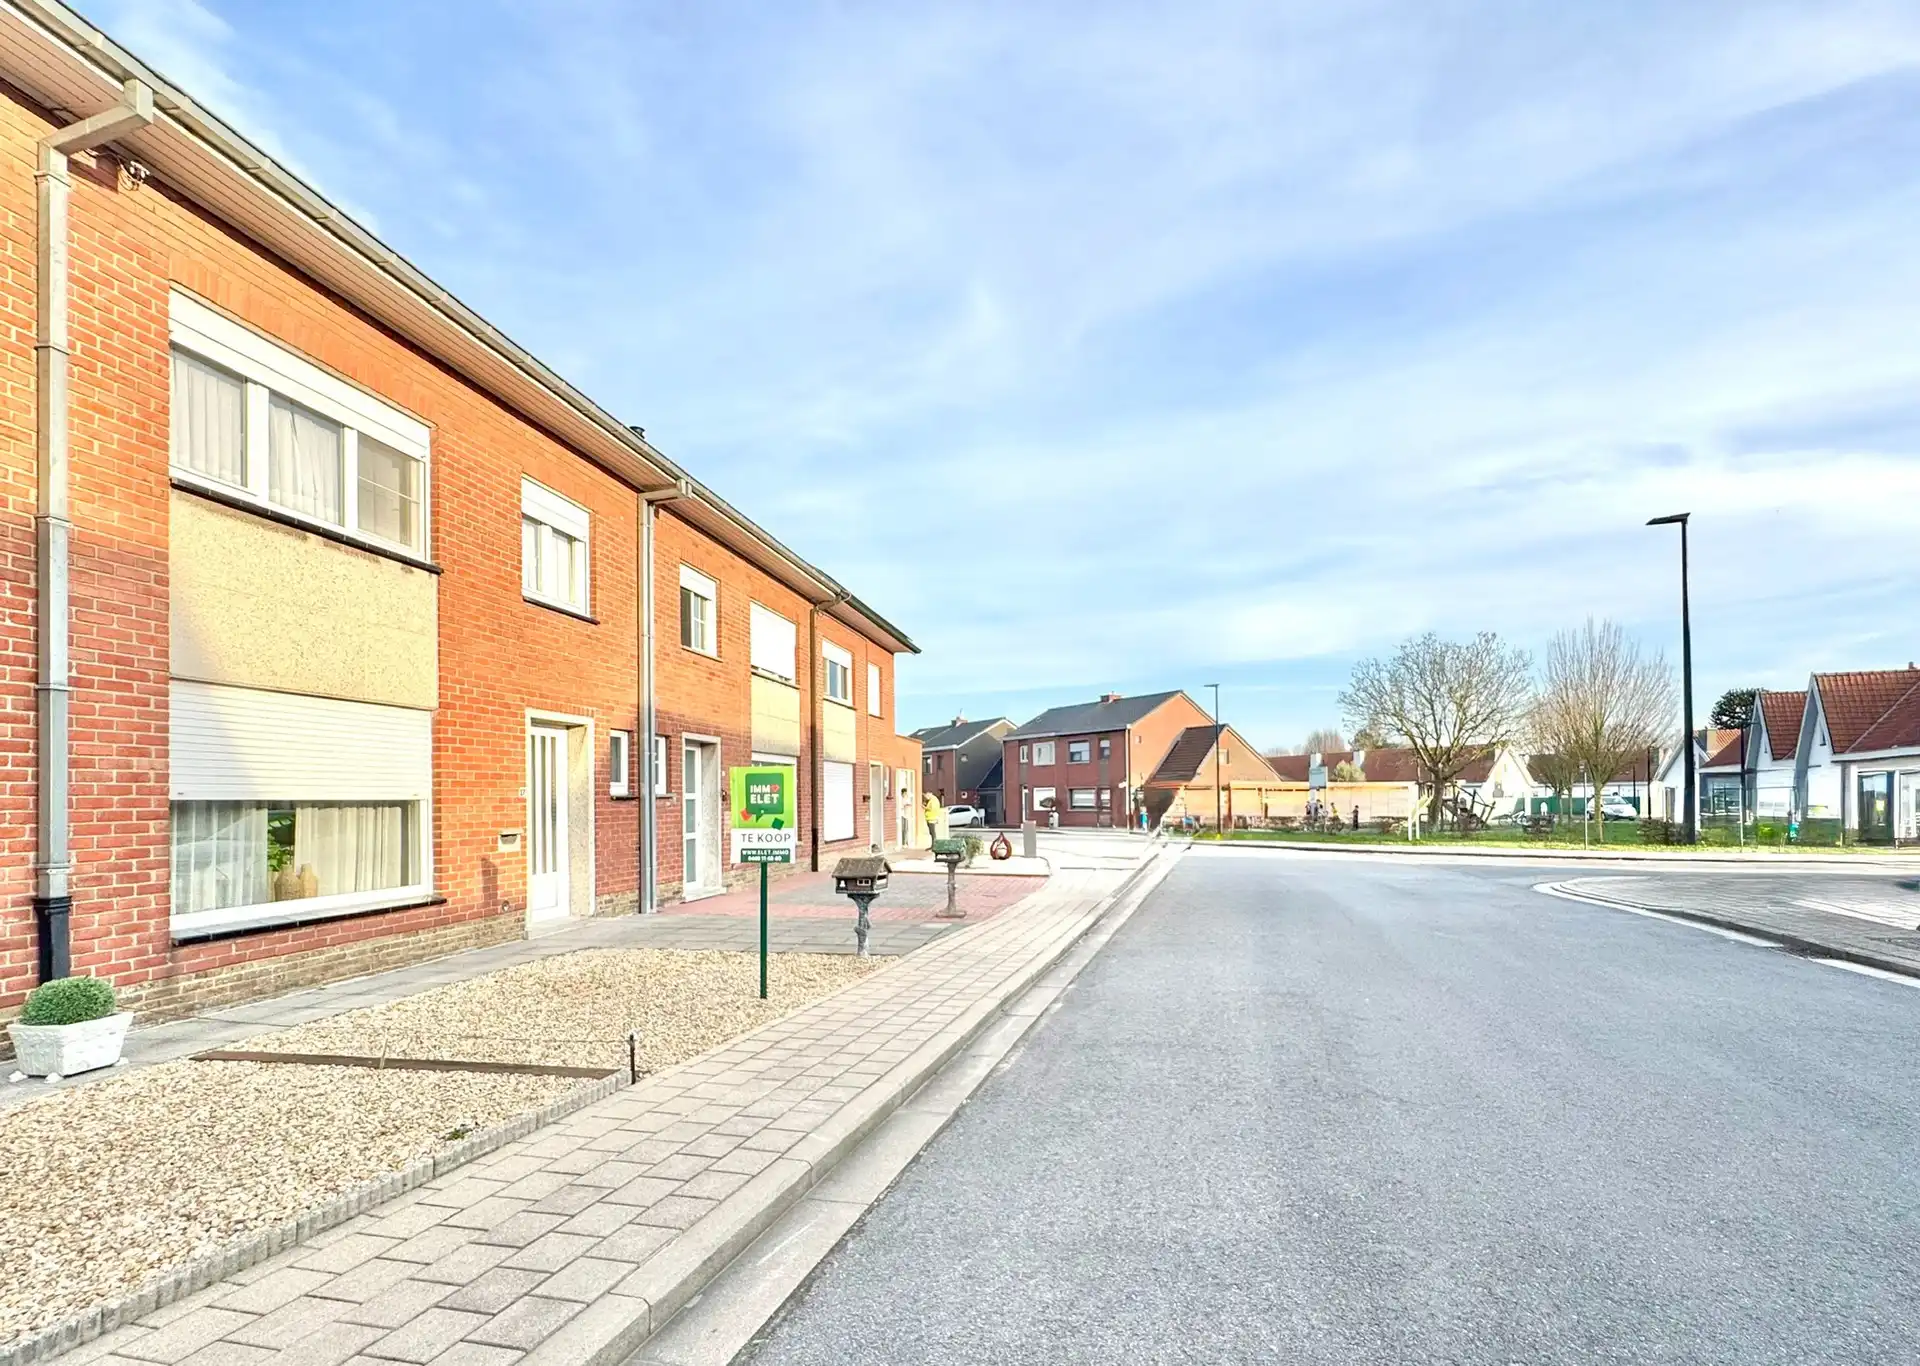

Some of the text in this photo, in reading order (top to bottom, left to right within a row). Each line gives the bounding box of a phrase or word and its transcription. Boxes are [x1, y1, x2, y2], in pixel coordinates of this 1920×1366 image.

[750, 794, 779, 804] ELET
[741, 834, 791, 842] TE KOOP
